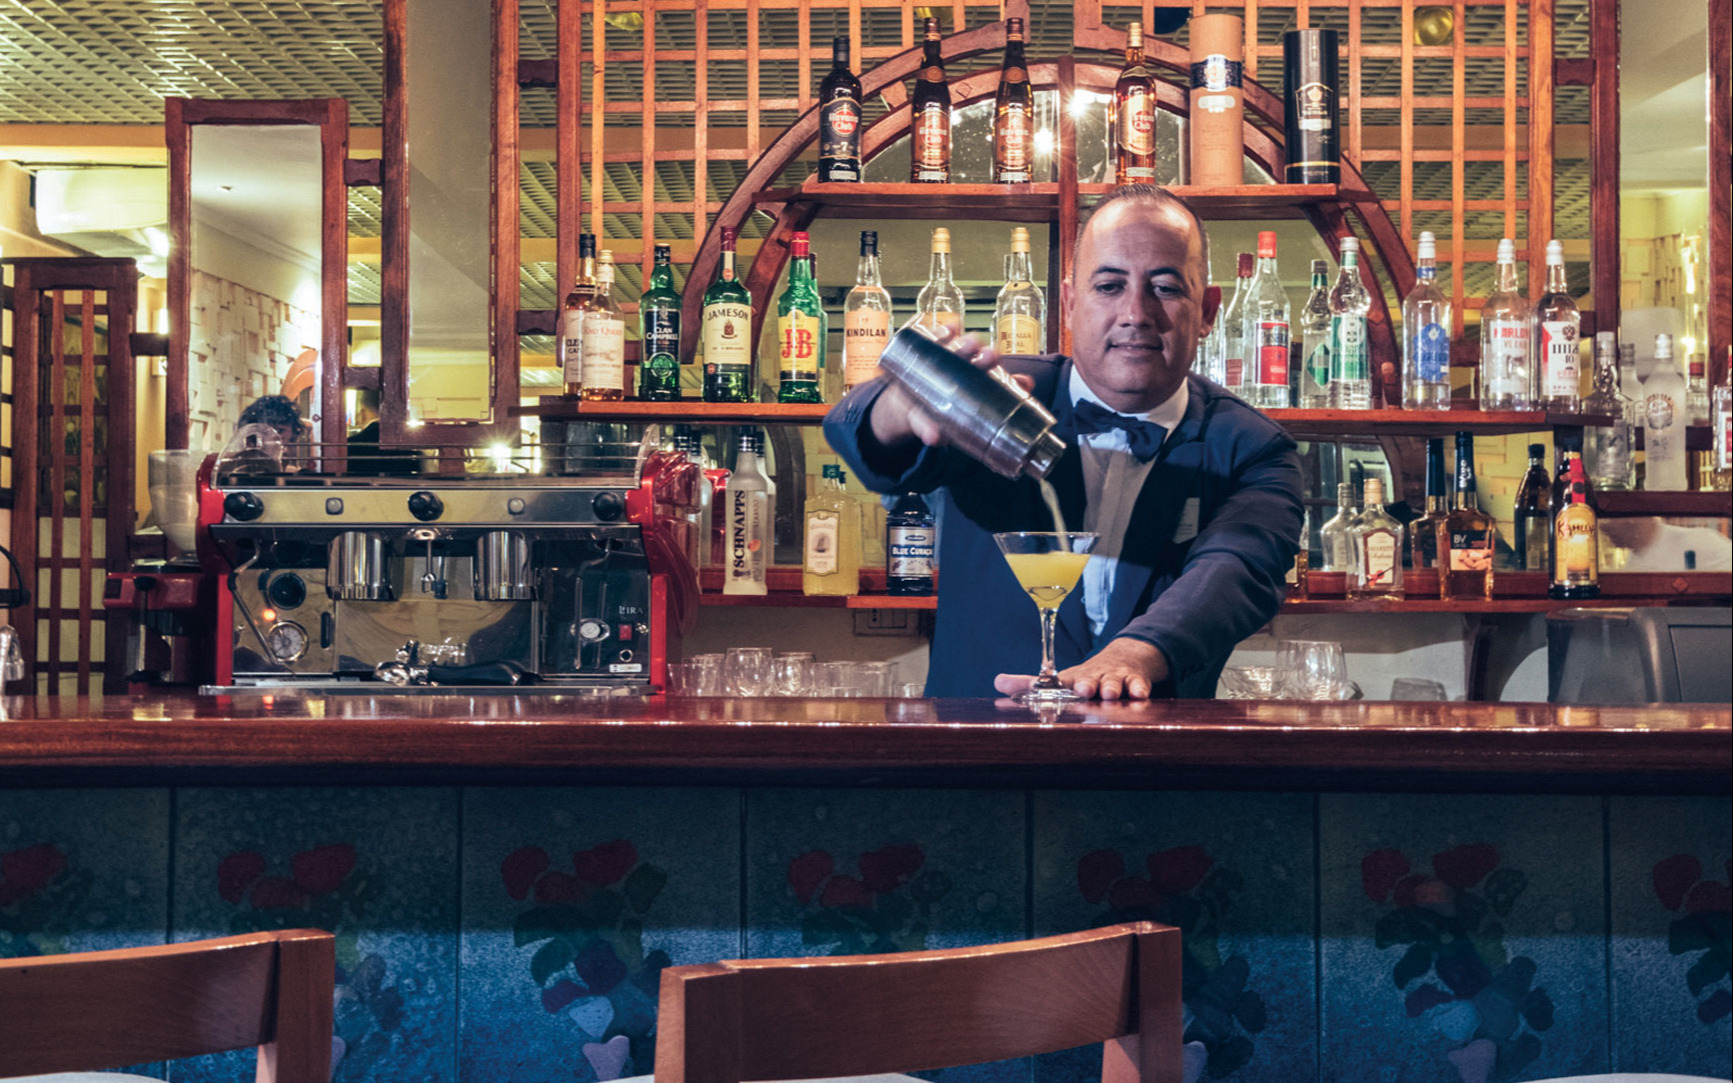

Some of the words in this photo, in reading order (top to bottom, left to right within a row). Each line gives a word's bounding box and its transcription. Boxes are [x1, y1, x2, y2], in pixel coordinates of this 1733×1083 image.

[834, 121, 854, 132] Club
[839, 141, 848, 151] 7
[707, 308, 749, 321] JAMESON
[646, 332, 679, 340] CAMPBELL
[733, 489, 746, 569] SCHNAPPS
[1453, 534, 1467, 544] BV
[892, 546, 909, 555] BLUE
